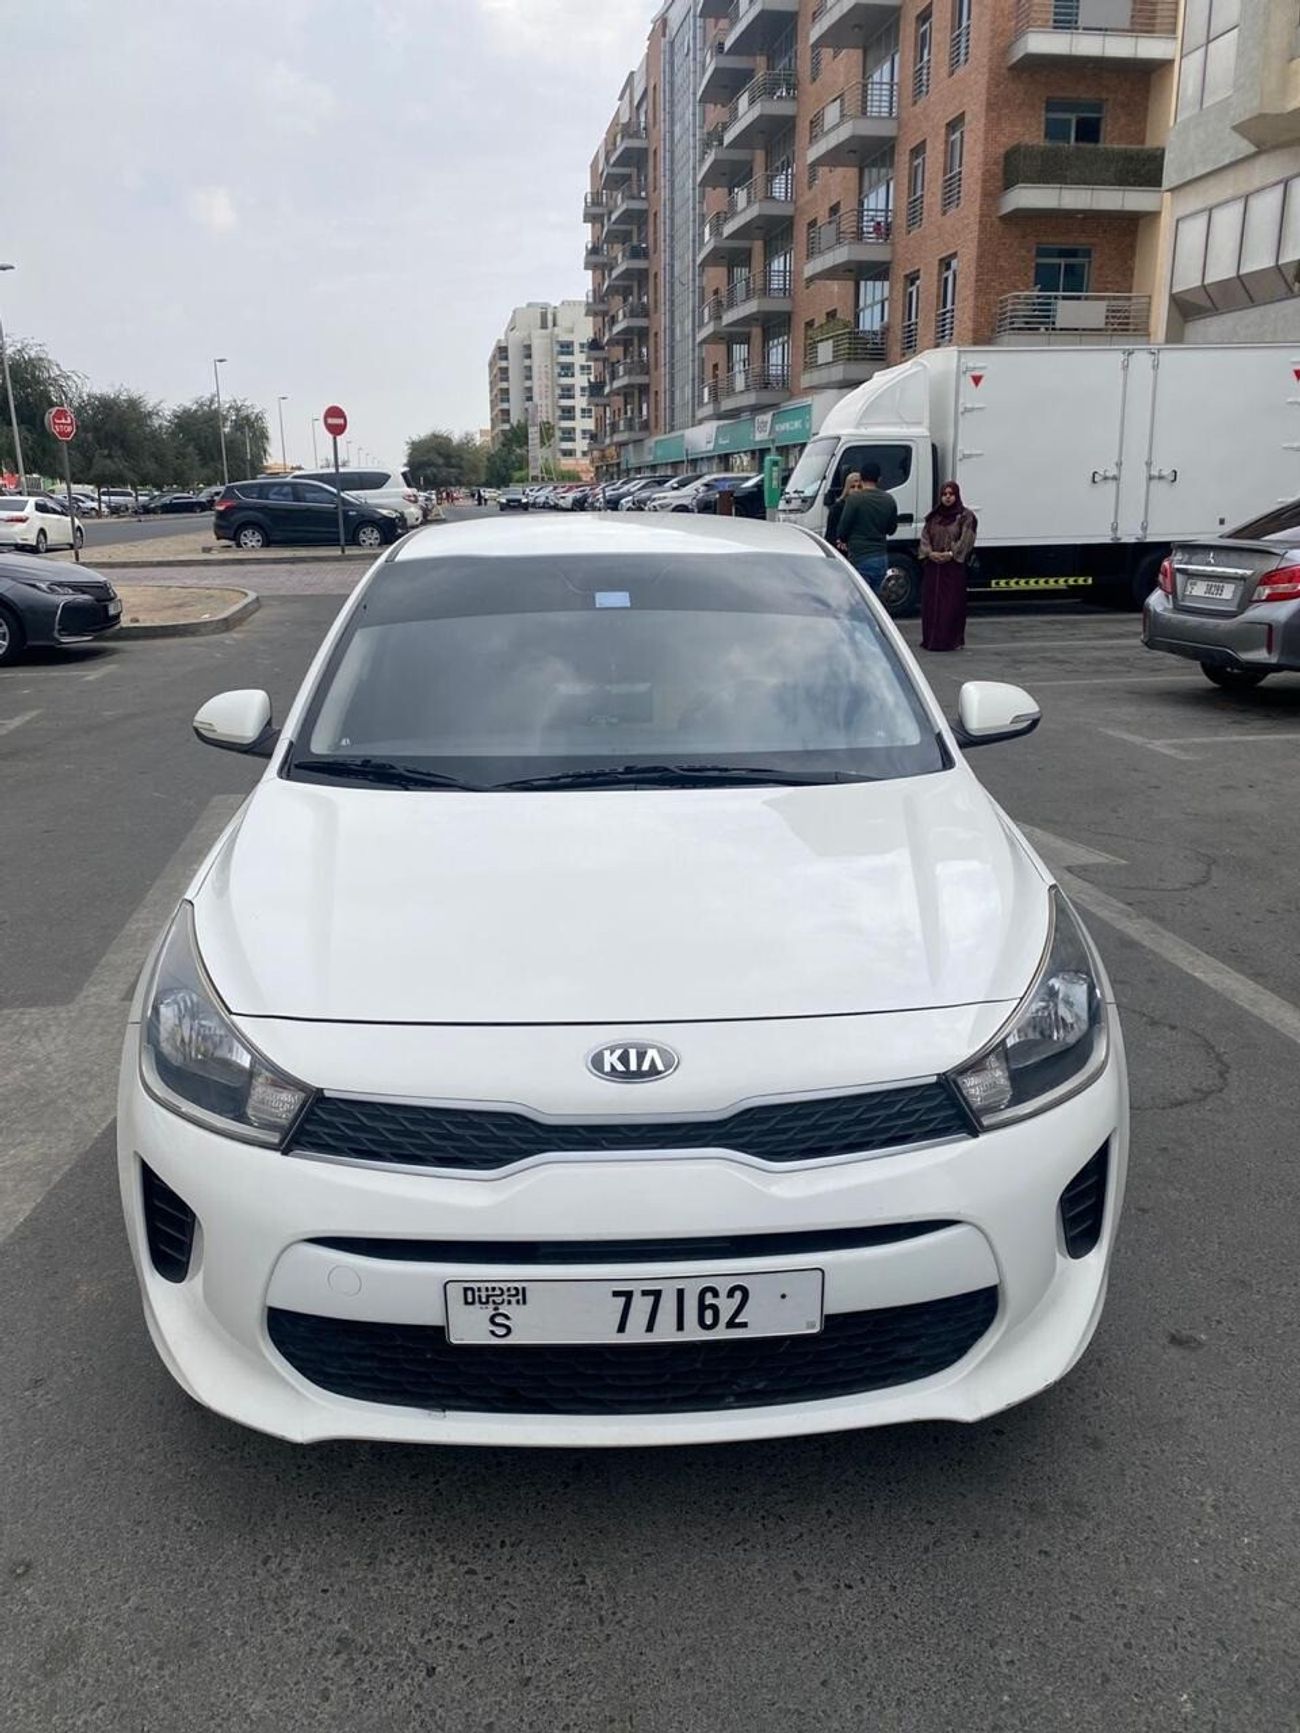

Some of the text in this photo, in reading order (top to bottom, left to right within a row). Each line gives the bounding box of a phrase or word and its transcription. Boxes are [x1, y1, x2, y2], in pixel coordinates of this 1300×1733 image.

[55, 425, 72, 433] STOP
[603, 1048, 665, 1072] KIA
[463, 1286, 527, 1306] DUBAI
[611, 1283, 750, 1334] 77162
[489, 1312, 512, 1338] S
